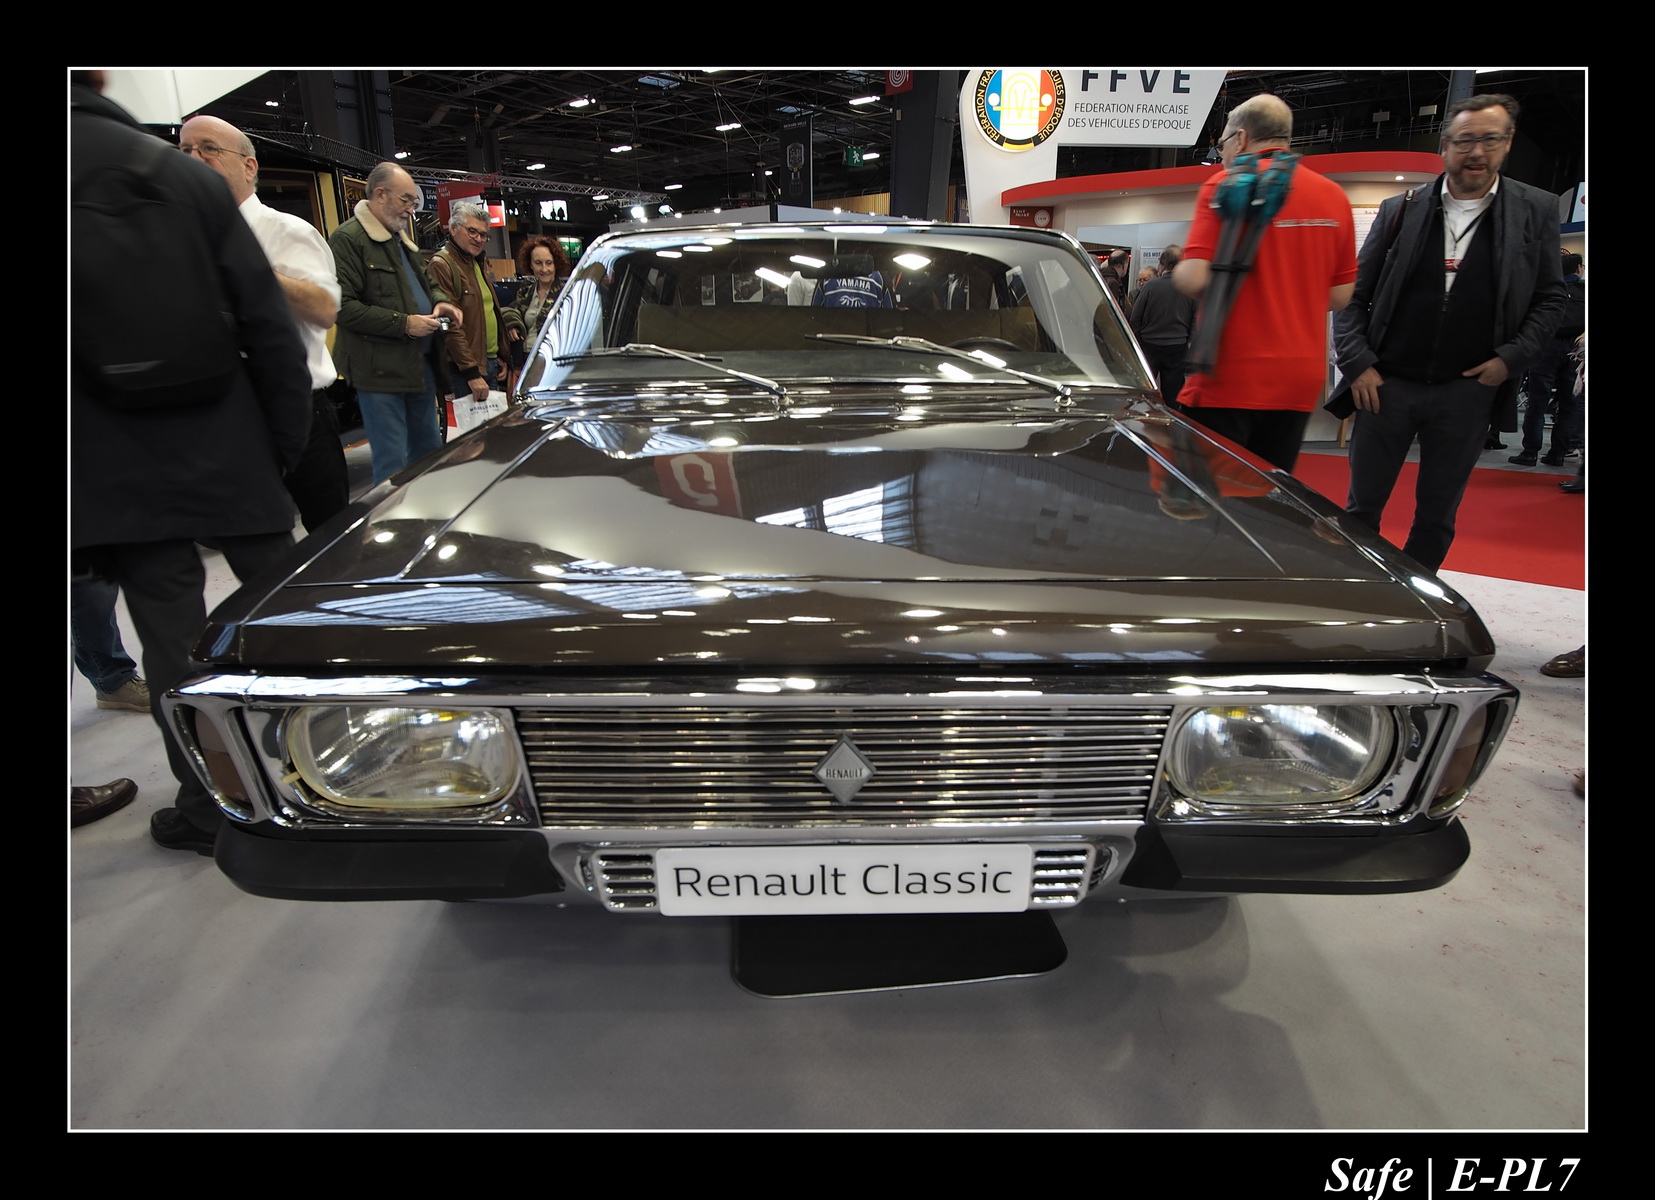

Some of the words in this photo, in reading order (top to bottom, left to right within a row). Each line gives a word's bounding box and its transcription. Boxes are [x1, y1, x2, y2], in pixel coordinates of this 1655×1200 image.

[1048, 69, 1065, 96] CULES
[1081, 70, 1190, 94] FFVE
[976, 89, 1001, 141] FÉDÉRATION
[1074, 103, 1134, 113] FEDERATION
[1136, 104, 1189, 114] FRANCAISE
[1068, 118, 1087, 128] DES
[1088, 118, 1140, 129] VEHICULES
[1142, 119, 1191, 130] D'EPOQUE
[837, 278, 871, 290] YAMAHA
[825, 768, 863, 778] RENAULT
[674, 864, 847, 897] Renault
[862, 863, 1012, 896] Classic
